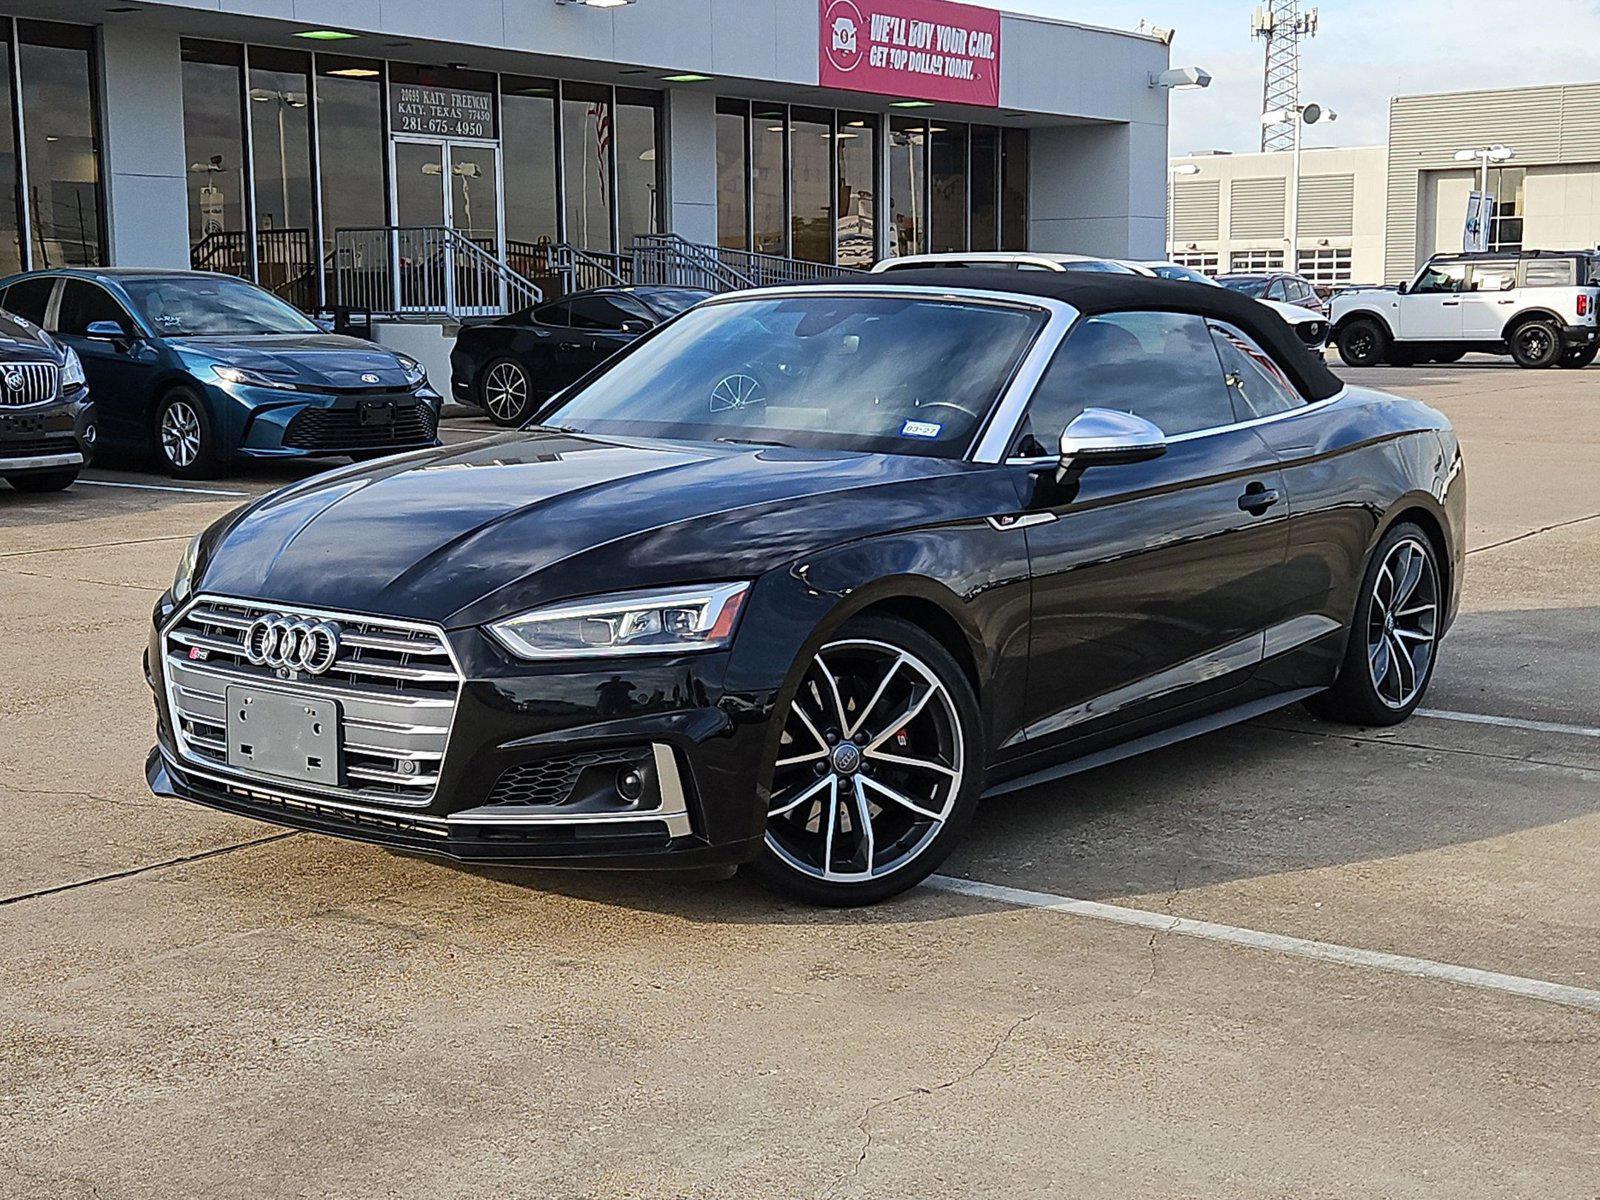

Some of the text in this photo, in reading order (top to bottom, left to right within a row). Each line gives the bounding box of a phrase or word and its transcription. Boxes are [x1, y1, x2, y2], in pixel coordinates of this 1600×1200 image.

[870, 13, 995, 60] WE'LL BUY YOUR CAR.
[869, 45, 974, 80] GET TOP DOLLAR TODAY.
[422, 90, 446, 106] KATY
[451, 93, 489, 110] FREEWAY
[430, 105, 462, 119] TEXAS
[402, 116, 482, 136] 281-675-4950
